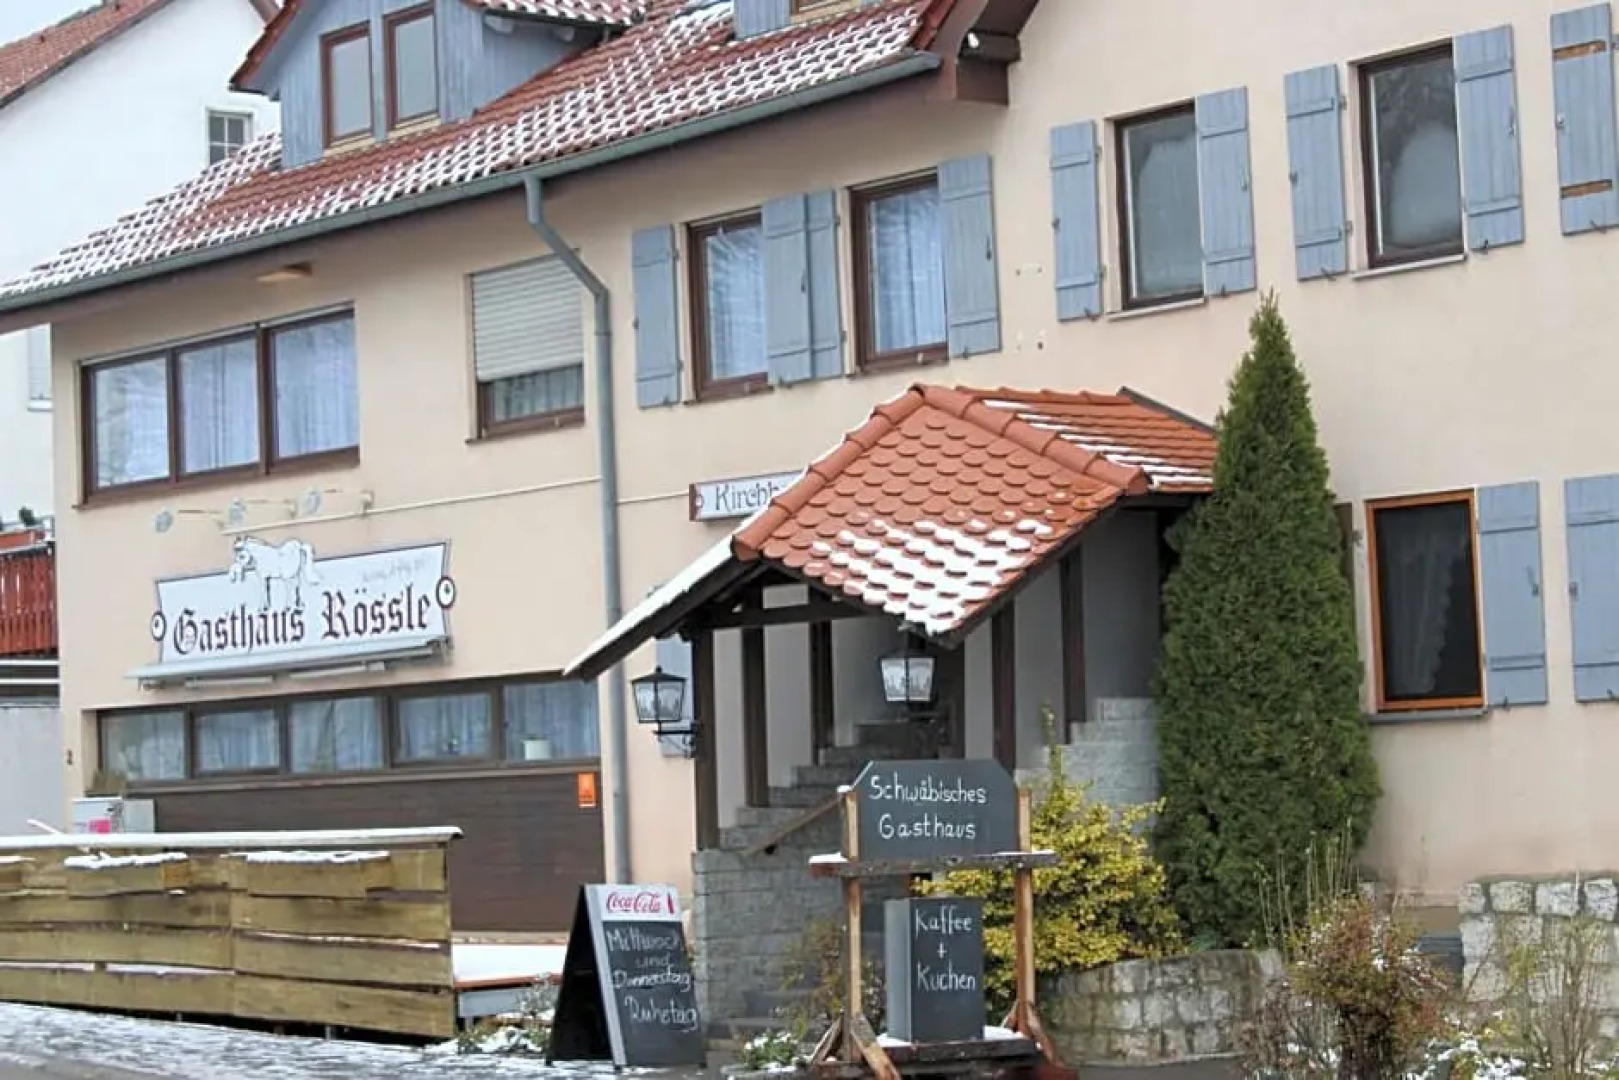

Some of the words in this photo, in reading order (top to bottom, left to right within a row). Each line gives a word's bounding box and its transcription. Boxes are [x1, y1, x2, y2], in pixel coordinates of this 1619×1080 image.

[173, 602, 305, 655] Gasthaus
[321, 582, 430, 639] Rössle
[868, 771, 987, 803] Schwäbisches
[879, 812, 976, 839] Gasthaus
[915, 905, 973, 940] Kaffee
[936, 942, 947, 959] +
[917, 962, 977, 991] Kuchen
[624, 996, 698, 1033] Ruhetag
